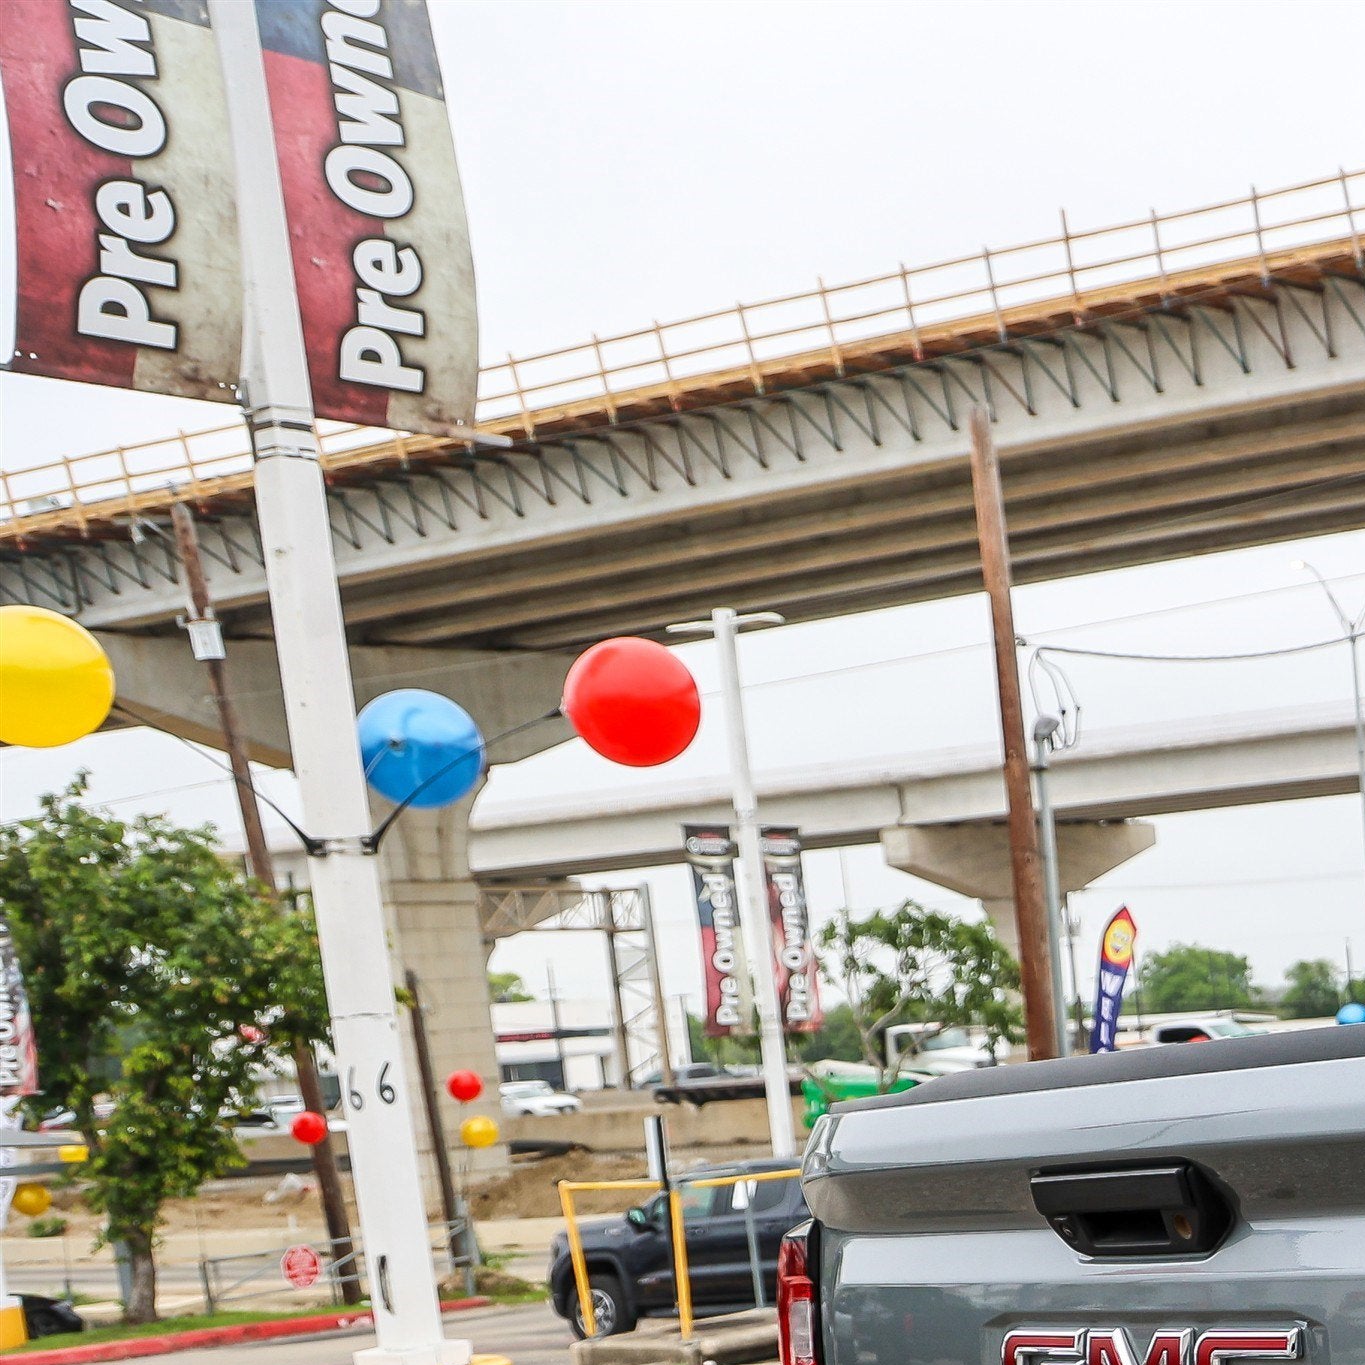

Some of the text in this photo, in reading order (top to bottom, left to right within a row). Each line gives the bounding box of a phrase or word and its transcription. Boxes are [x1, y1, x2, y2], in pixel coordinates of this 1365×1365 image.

[77, 179, 177, 350] Pre
[338, 238, 425, 393] Pre
[701, 873, 736, 973] Owned
[771, 872, 805, 971] Owned
[715, 976, 741, 1026] Pre
[786, 972, 812, 1022] Pre
